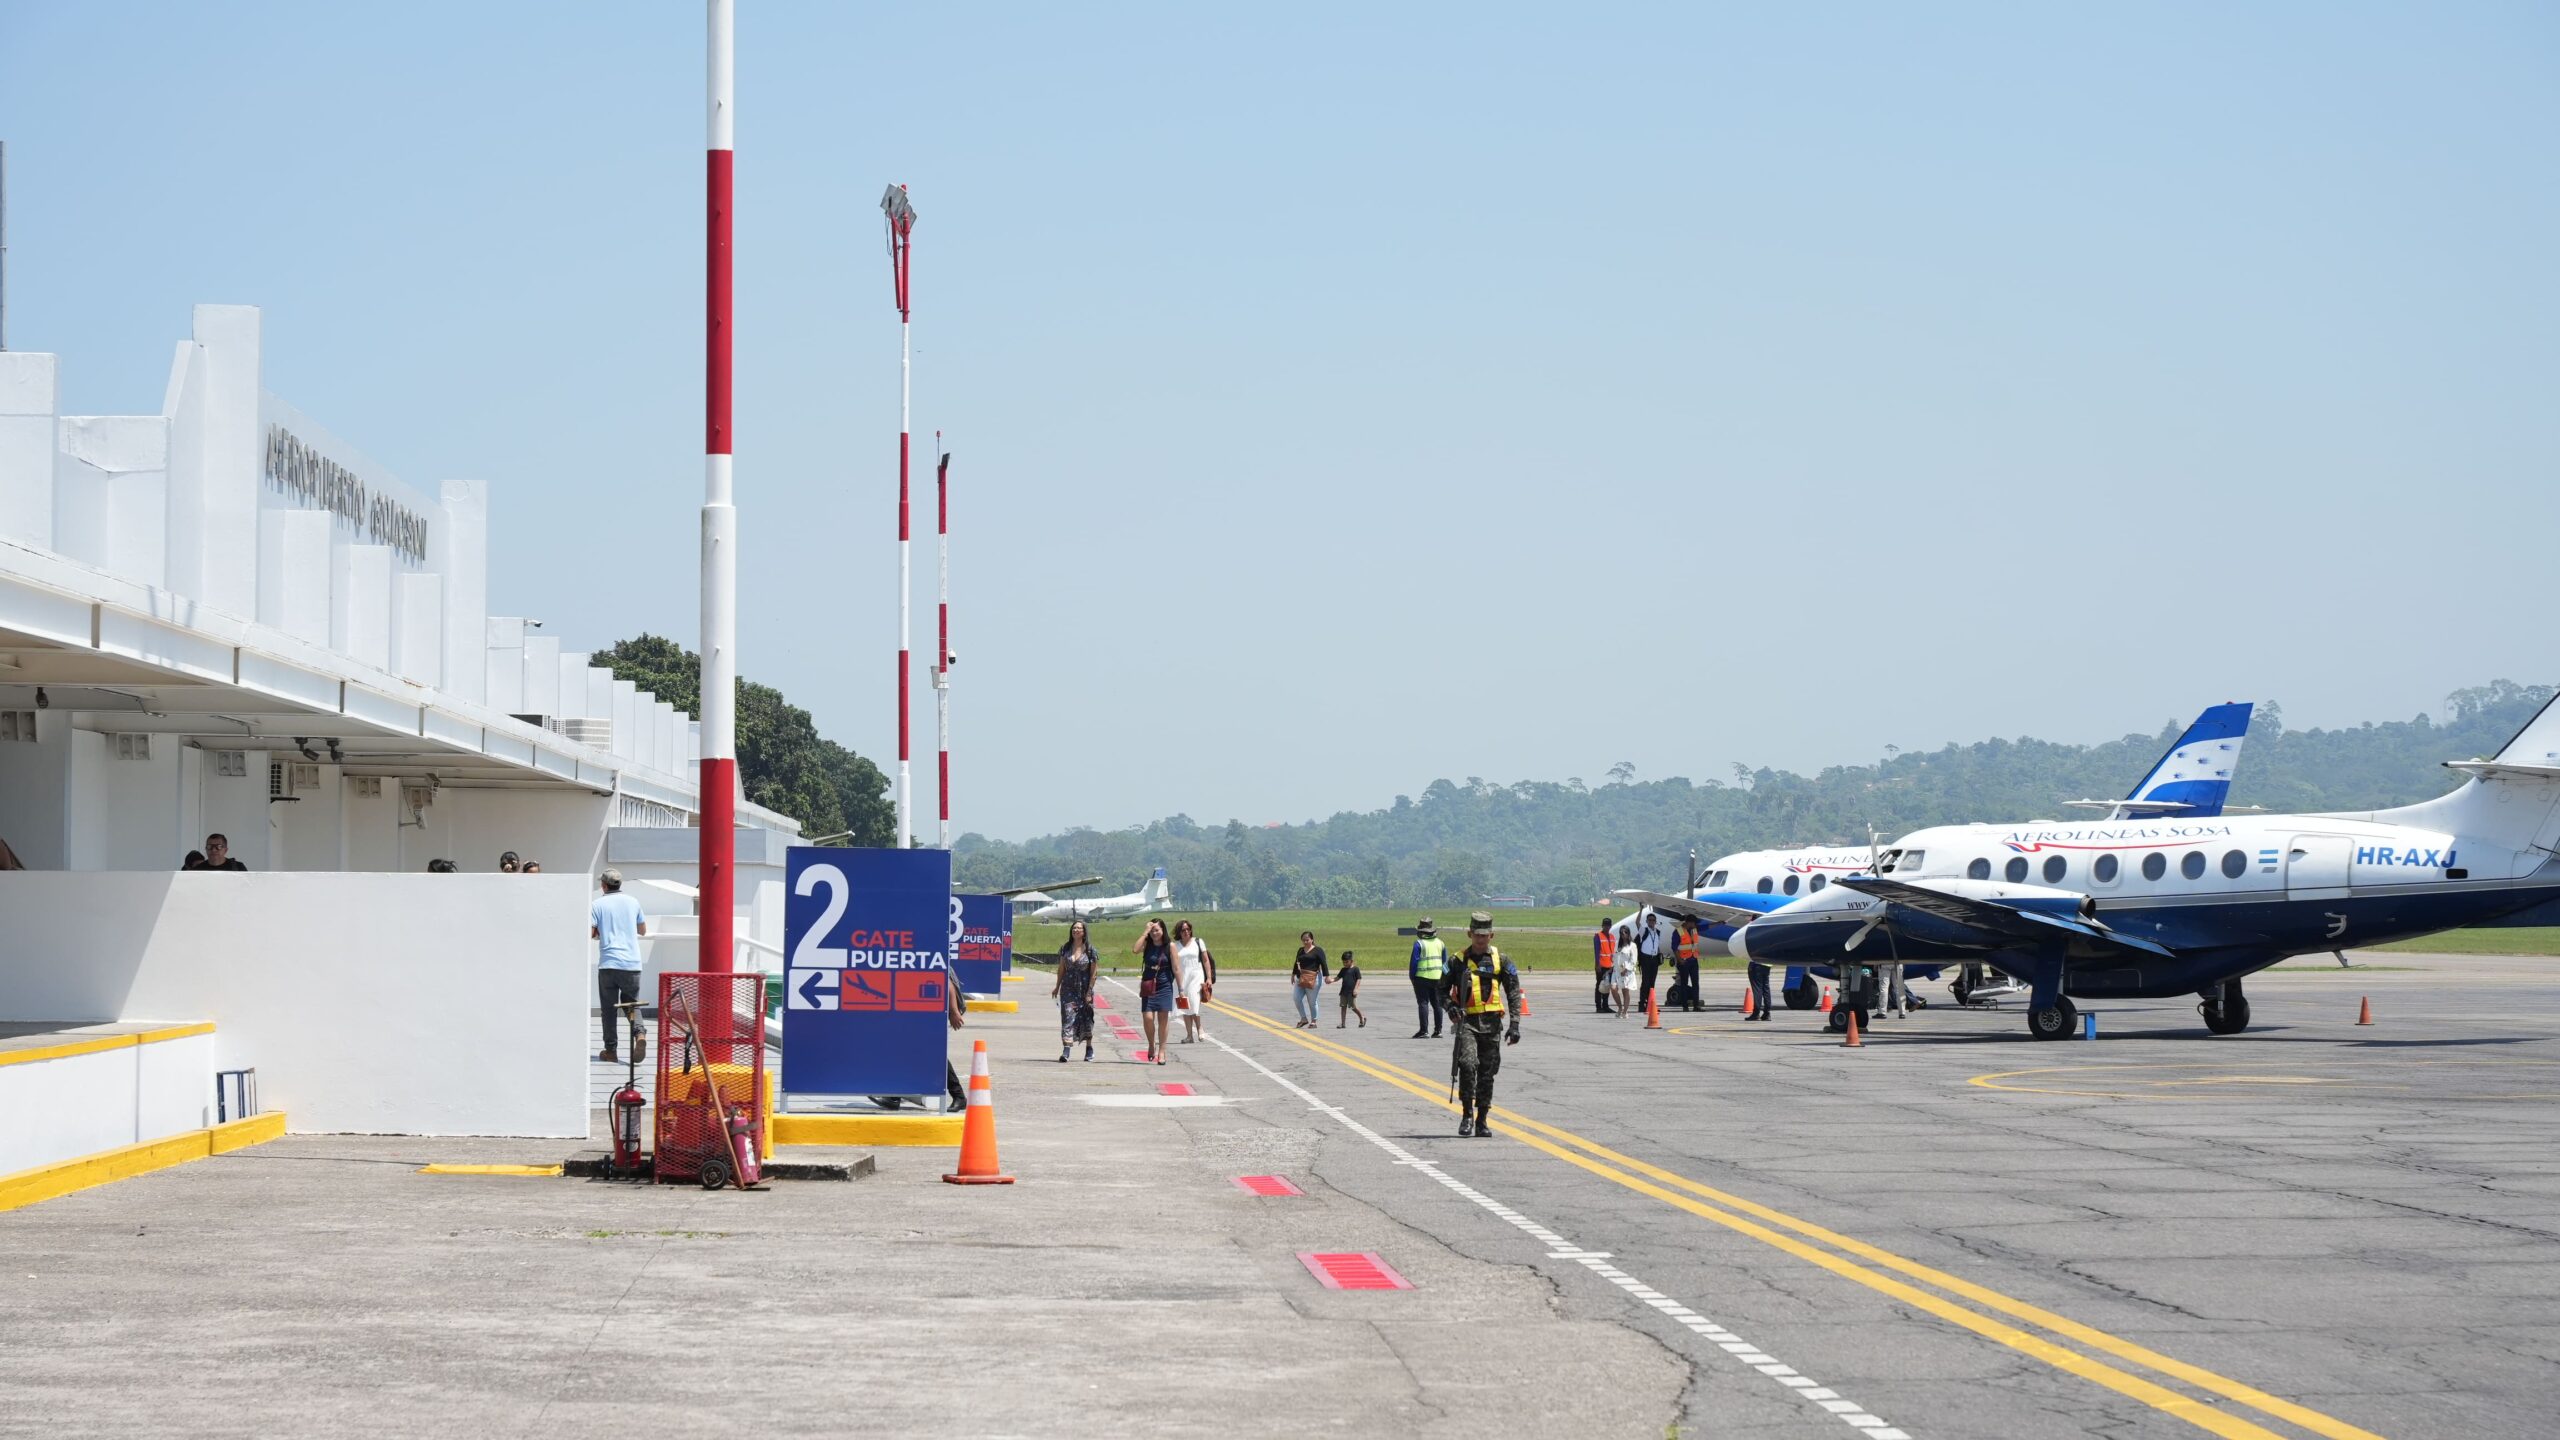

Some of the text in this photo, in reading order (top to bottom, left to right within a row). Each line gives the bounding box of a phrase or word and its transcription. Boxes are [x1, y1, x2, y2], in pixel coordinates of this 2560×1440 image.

[266, 423, 364, 526] AEROPUERTO
[2003, 825, 2231, 842] AEROLINEAS SOSA
[1783, 855, 1873, 866] AEROLINE
[2357, 847, 2456, 868] HR-AXJ
[792, 863, 849, 968] 2
[850, 930, 914, 948] GATE
[963, 927, 989, 936] GATE
[963, 935, 1002, 944] PUERTA
[851, 951, 947, 969] PUERTA
